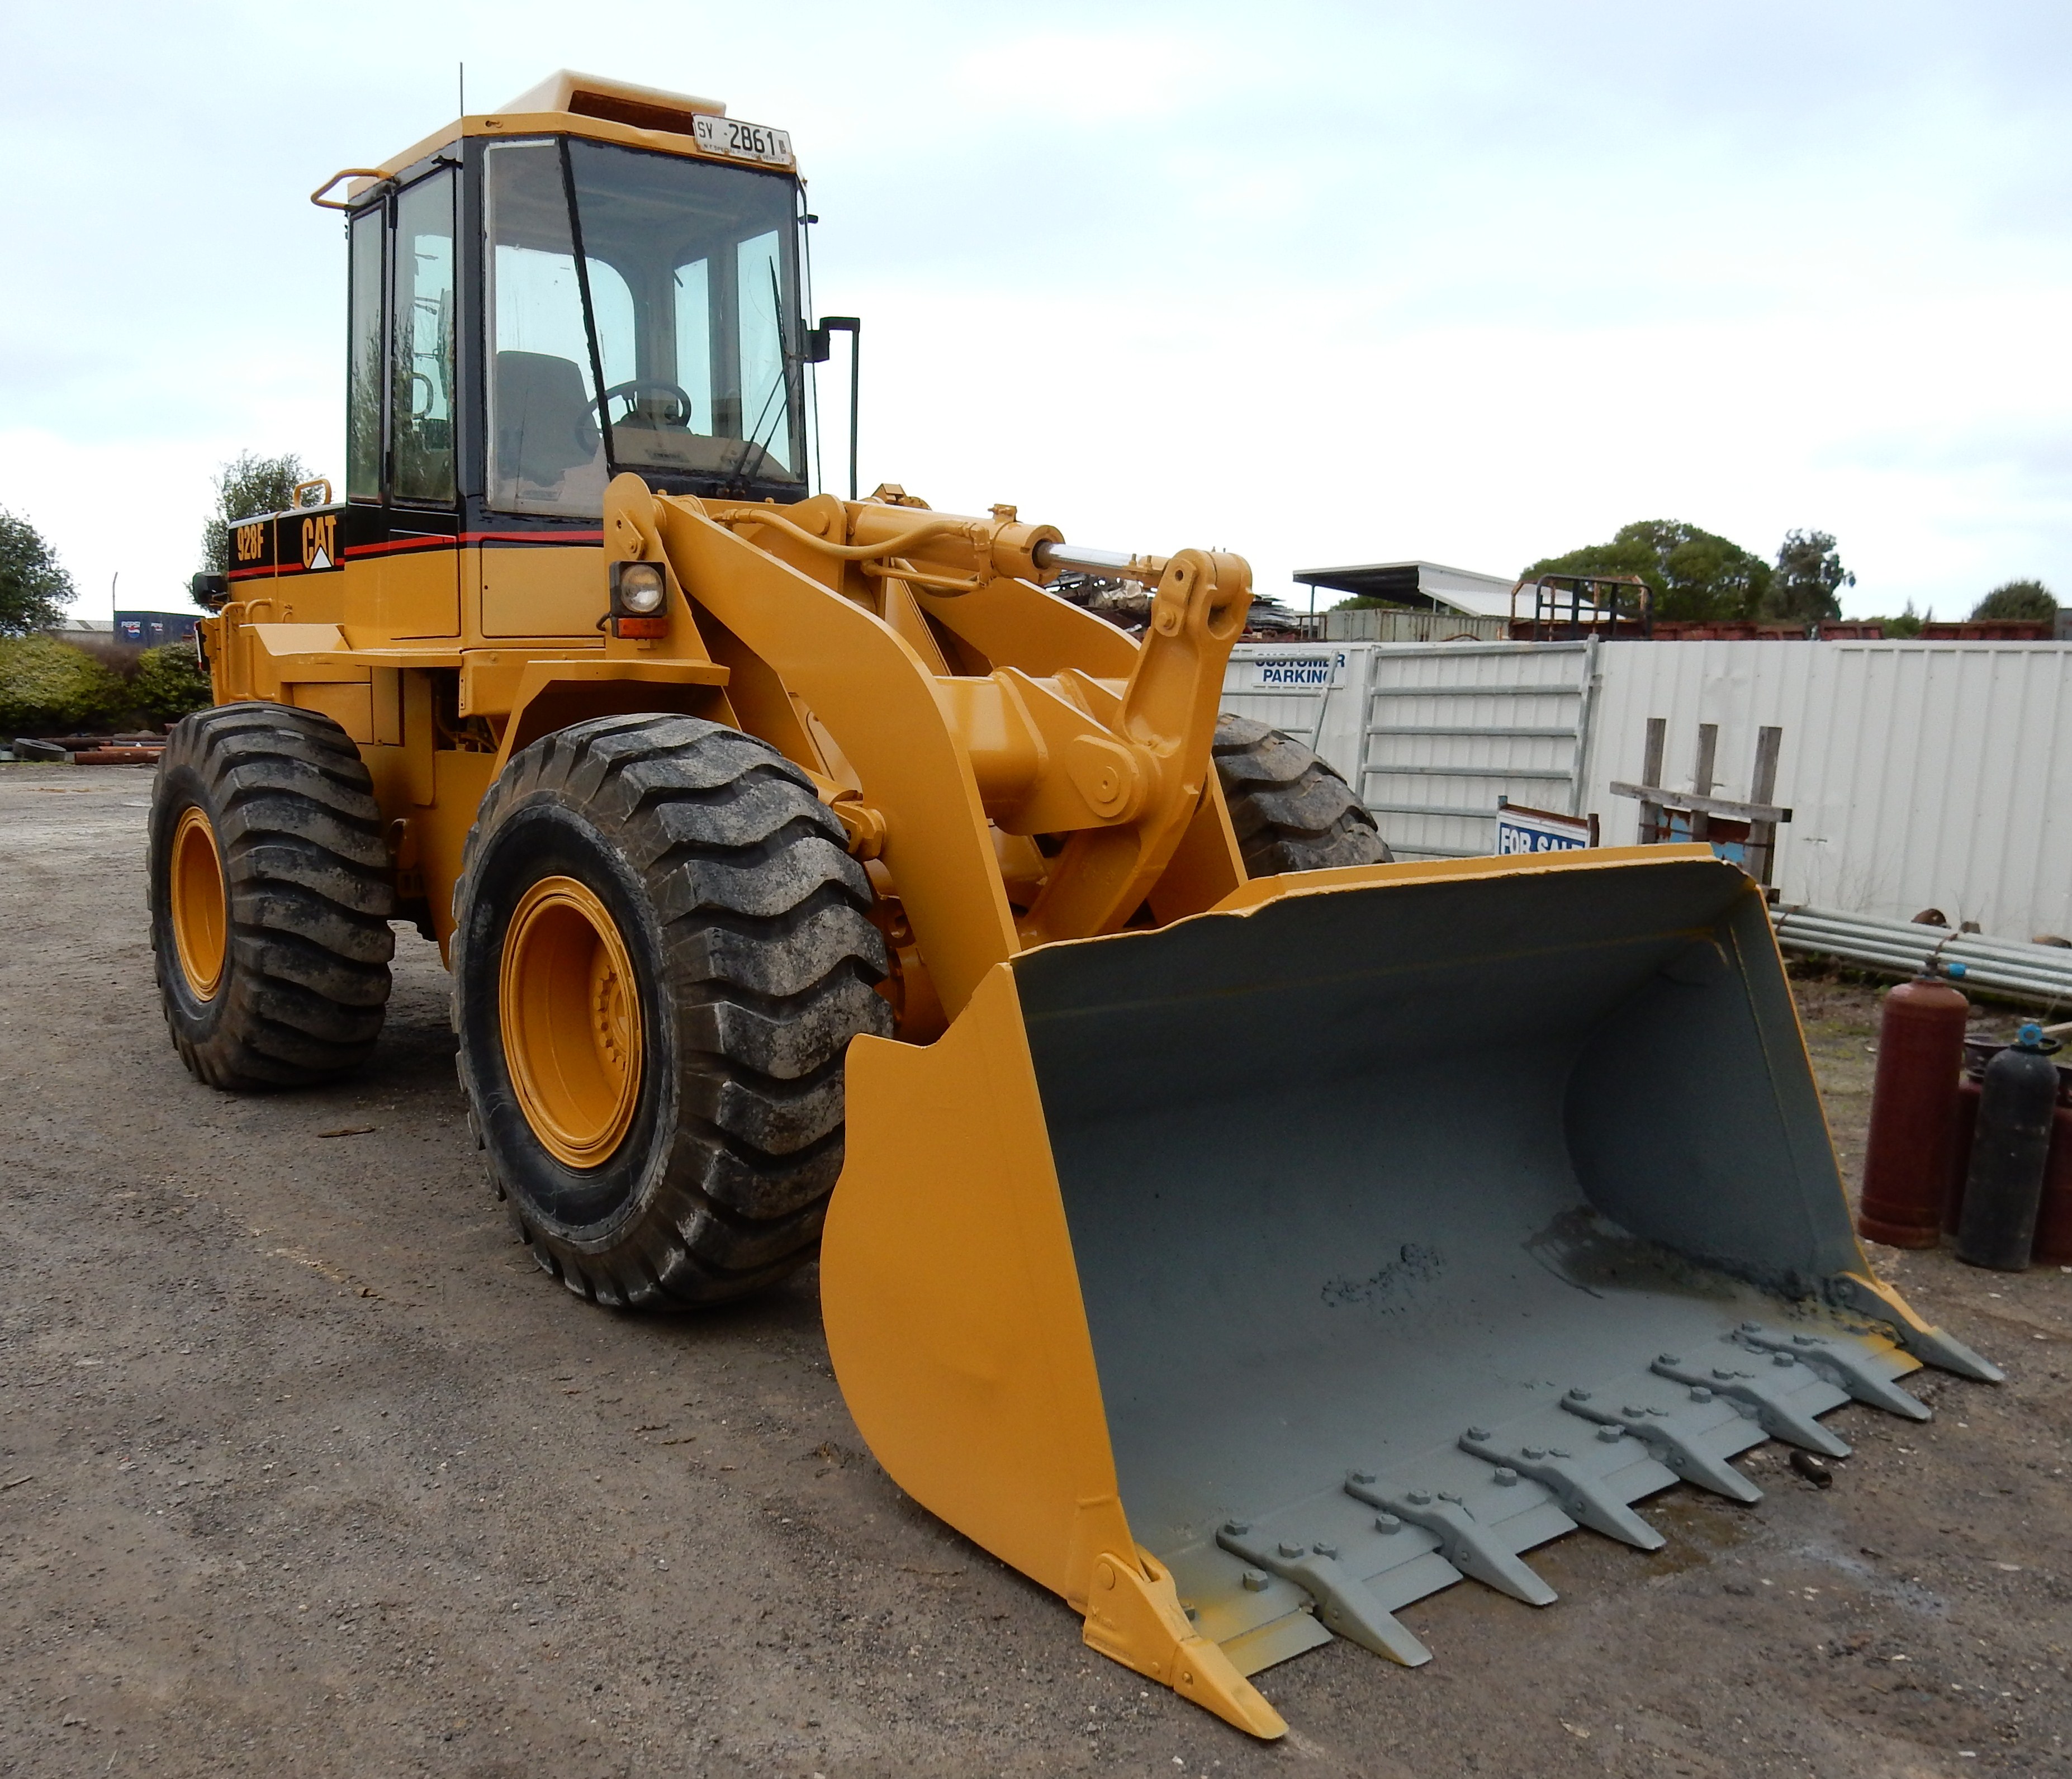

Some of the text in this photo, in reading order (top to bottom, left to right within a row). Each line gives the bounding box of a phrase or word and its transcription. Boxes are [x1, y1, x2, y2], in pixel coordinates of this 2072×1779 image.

[698, 121, 775, 156] SY 2861
[237, 523, 264, 561] 928F
[302, 515, 336, 569] CAT
